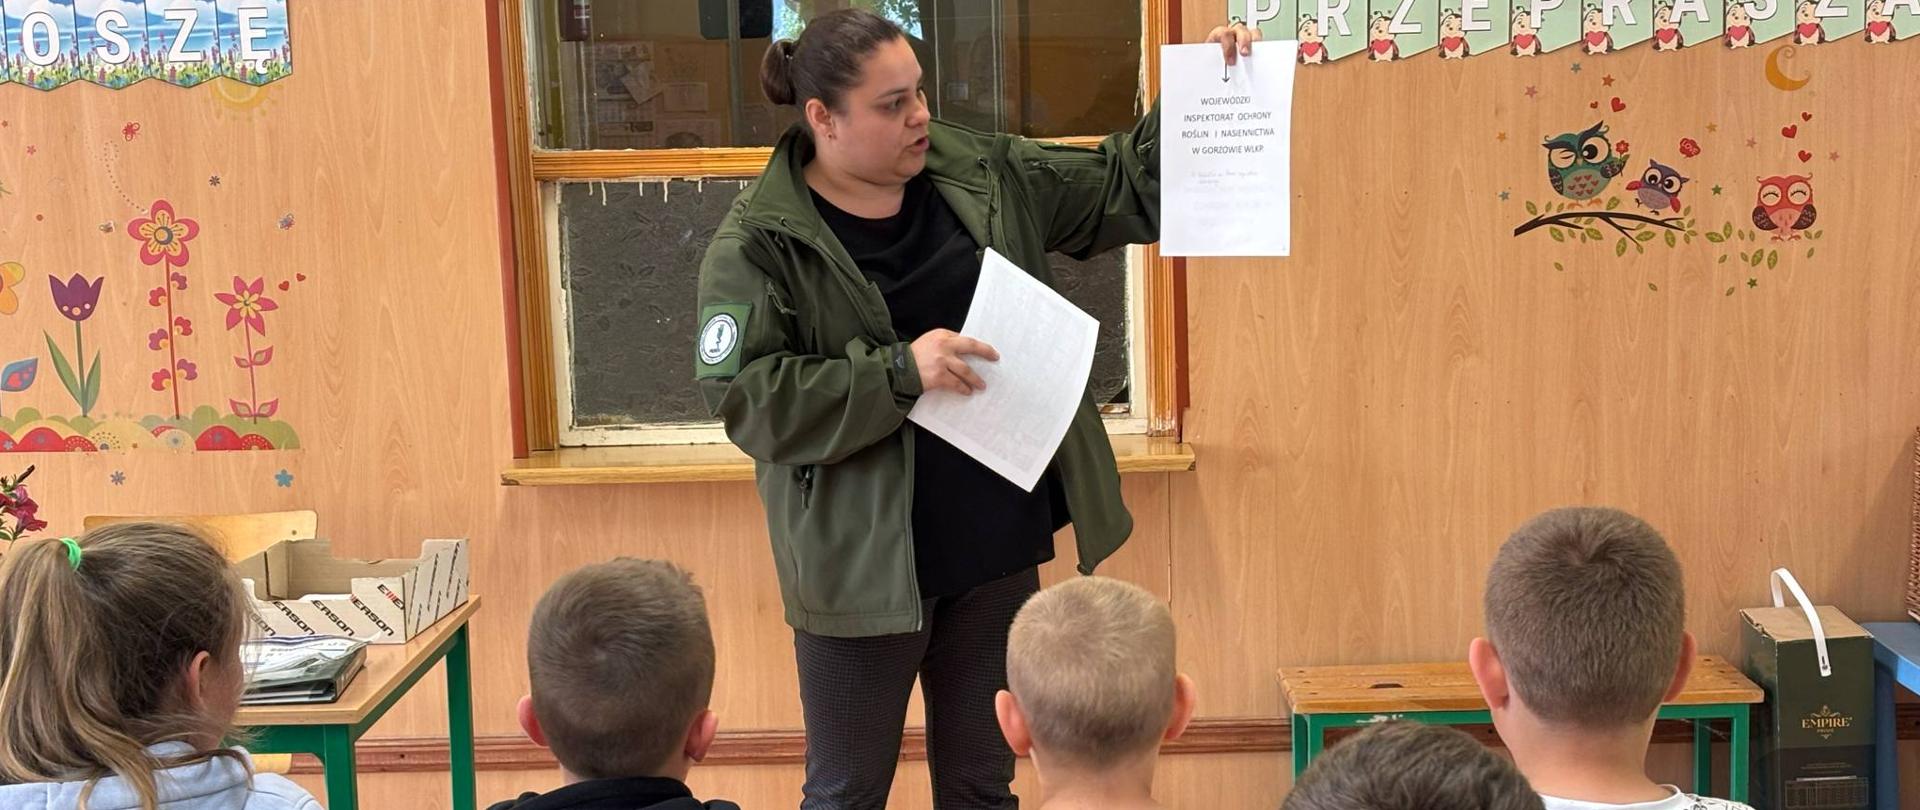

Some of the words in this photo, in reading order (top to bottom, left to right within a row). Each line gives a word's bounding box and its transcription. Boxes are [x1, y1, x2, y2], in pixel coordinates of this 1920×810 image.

[1200, 96, 1251, 106] WOJEWÓDZKI
[1184, 113, 1234, 122] INSPEKTORAT
[1238, 112, 1272, 121] OCHRONY
[1182, 129, 1209, 139] ROŚLIN
[1221, 128, 1275, 138] NASIENNICTWA
[1192, 147, 1200, 155] W
[1202, 145, 1242, 154] GORZOWIE
[1802, 717, 1850, 728] EMPIRE
